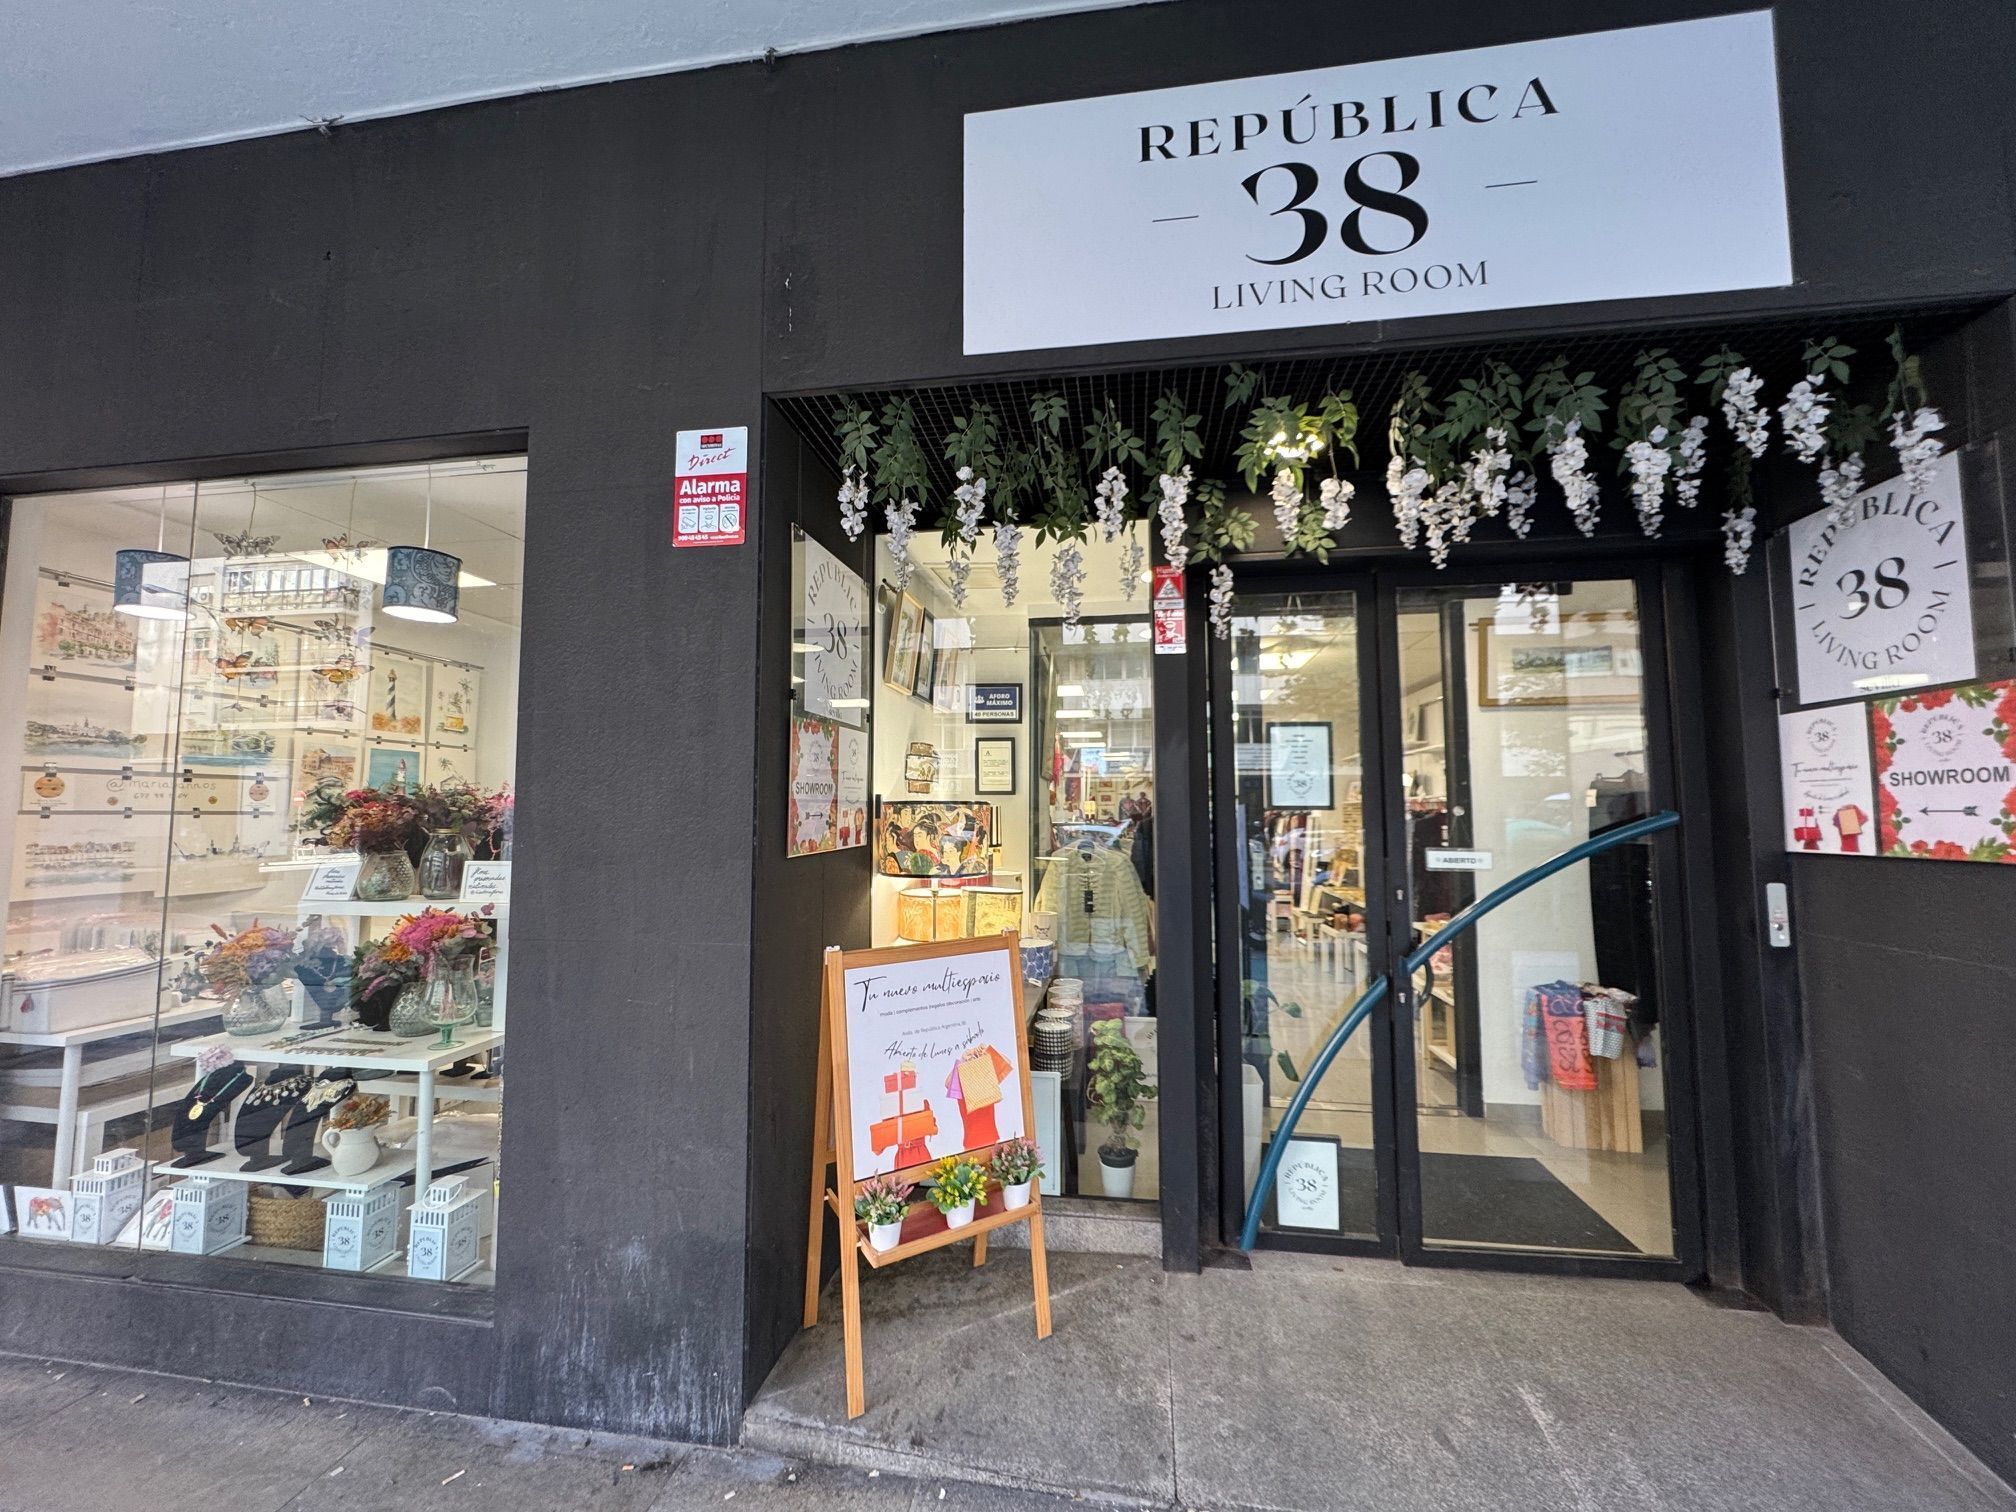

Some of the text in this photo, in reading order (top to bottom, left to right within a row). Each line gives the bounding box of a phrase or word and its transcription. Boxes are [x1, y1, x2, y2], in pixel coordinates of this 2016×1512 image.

[1138, 76, 1560, 163] REPÚBLICA
[1240, 150, 1430, 266] 38
[1211, 260, 1489, 310] LIVING ROOM
[688, 448, 736, 470] Direct
[680, 478, 740, 495] Alarma
[693, 495, 710, 503] aviso
[1799, 492, 1956, 587] REPBLICA
[1836, 556, 1910, 620] 38
[824, 612, 848, 660] 38
[1812, 589, 1952, 670] LIVING ROOM
[1932, 730, 1953, 744] 38
[1889, 766, 2010, 787] SHOWROOM
[796, 781, 834, 795] SHOWROOM
[853, 967, 1000, 1012] Tu nuevo multiespacio
[884, 1040, 917, 1062] Abierto
[918, 1043, 928, 1059] de
[1295, 1178, 1318, 1192] 38
[338, 1236, 350, 1246] 38
[421, 1247, 433, 1257] 38
